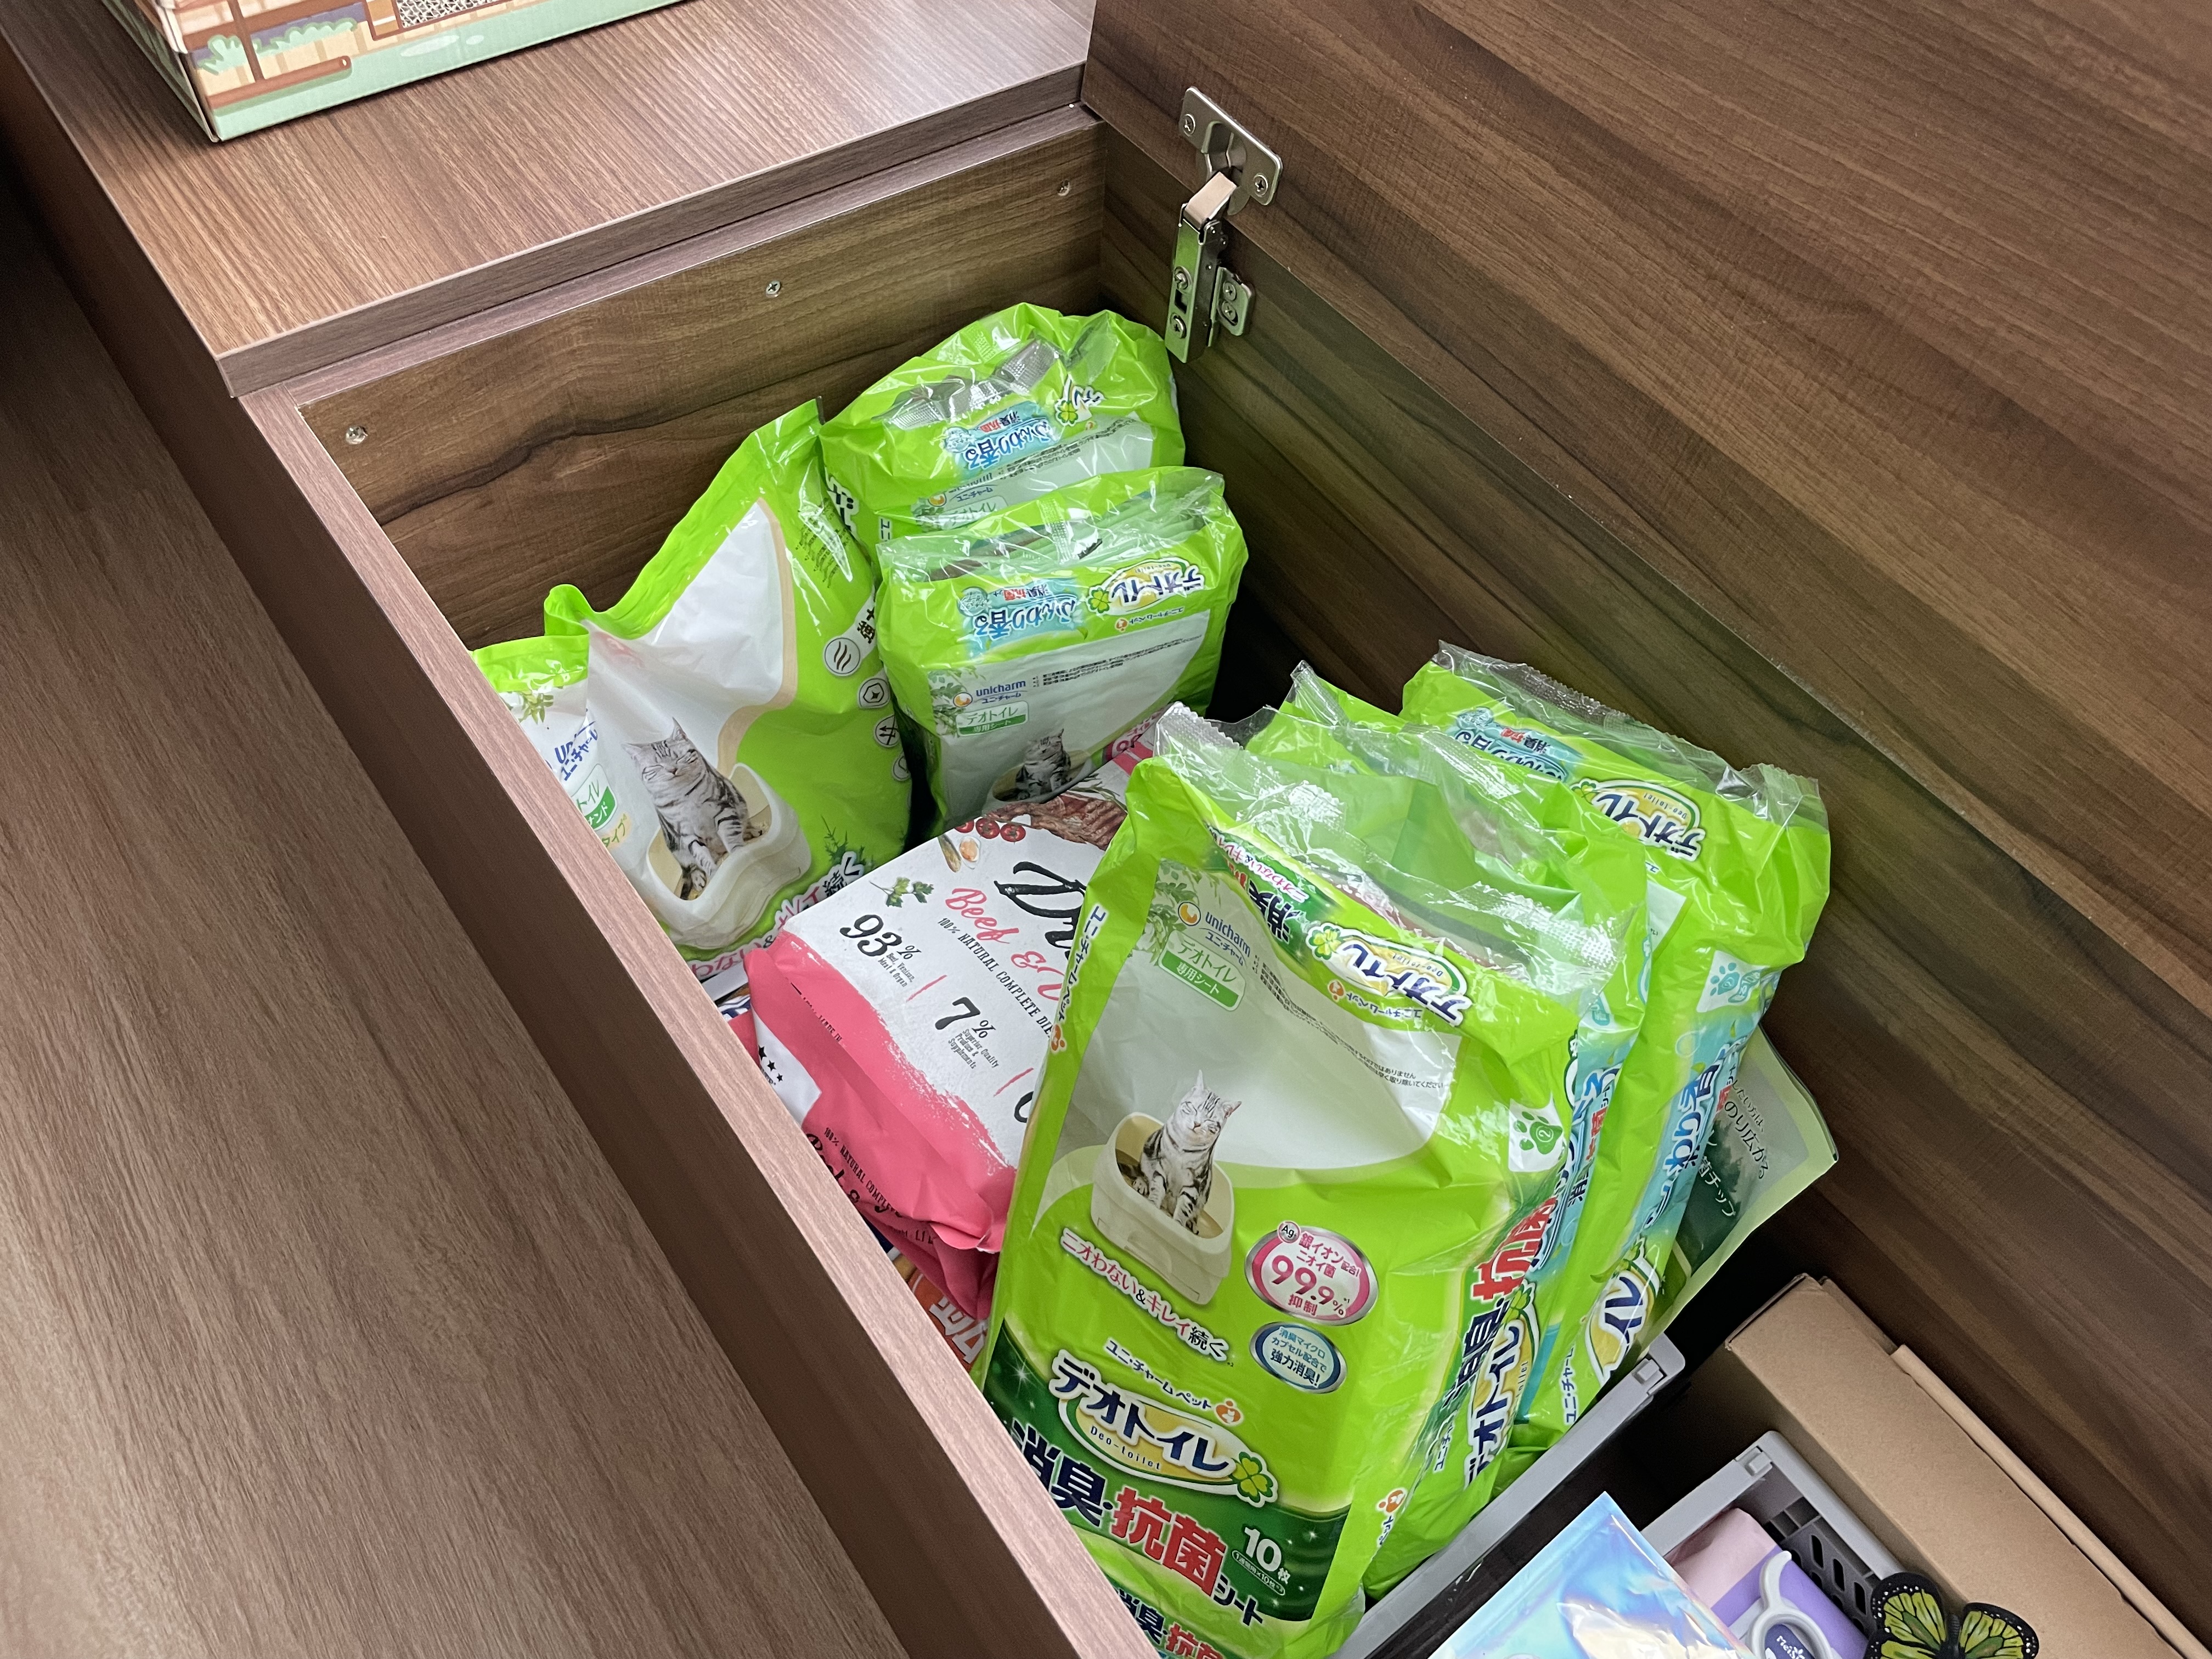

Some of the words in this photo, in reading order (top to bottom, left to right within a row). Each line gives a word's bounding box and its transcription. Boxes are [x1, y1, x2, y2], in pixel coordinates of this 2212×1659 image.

[966, 420, 1050, 468] ふんわり香る
[1111, 568, 1204, 603] デオトイレ
[975, 598, 1076, 640] ふんわり香る
[1128, 606, 1184, 624] ユニ・チャームペット
[976, 680, 1026, 697] unicharm
[981, 692, 1022, 704] ユニ・チャーム
[966, 707, 1019, 725] デオトイレ
[1596, 793, 1705, 857] デオトイレ
[945, 888, 1019, 944] Beef
[1205, 911, 1251, 958] unicharm
[1058, 906, 1106, 1022] ユニ・チャームペット
[1177, 939, 1237, 982] デオトイレ
[1205, 931, 1244, 967] ユニ・チャーム
[938, 918, 961, 934] 100%
[957, 933, 995, 972] NATURAL
[995, 970, 1041, 1018] COMPLETE
[1036, 1015, 1053, 1039] DIE
[1176, 962, 1220, 994] 専用シート
[1341, 943, 1466, 1023] デオトイレ
[1346, 990, 1421, 1018] ユニ・チャームペット
[1724, 1101, 1768, 1179] のり広がる
[1296, 1249, 1336, 1279] ニオイ菌
[1298, 1233, 1361, 1277] 銀イオン配合!
[1062, 1232, 1228, 1359] ニオわない&キレイ続く
[1271, 1255, 1345, 1316] 99.9%
[1288, 1294, 1318, 1316] 抑制
[1271, 1337, 1327, 1373] カプセル配合で
[1279, 1328, 1326, 1359] 消臭マイクロ
[1105, 1340, 1211, 1410] ユニ・チャームペット
[1270, 1348, 1321, 1386] 強力消臭!
[1054, 1356, 1229, 1472] デオトイレ
[1090, 1425, 1161, 1471] Deo-toilet
[1014, 1423, 1263, 1626] 消臭・抗菌シート
[1244, 1527, 1290, 1584] 10枚
